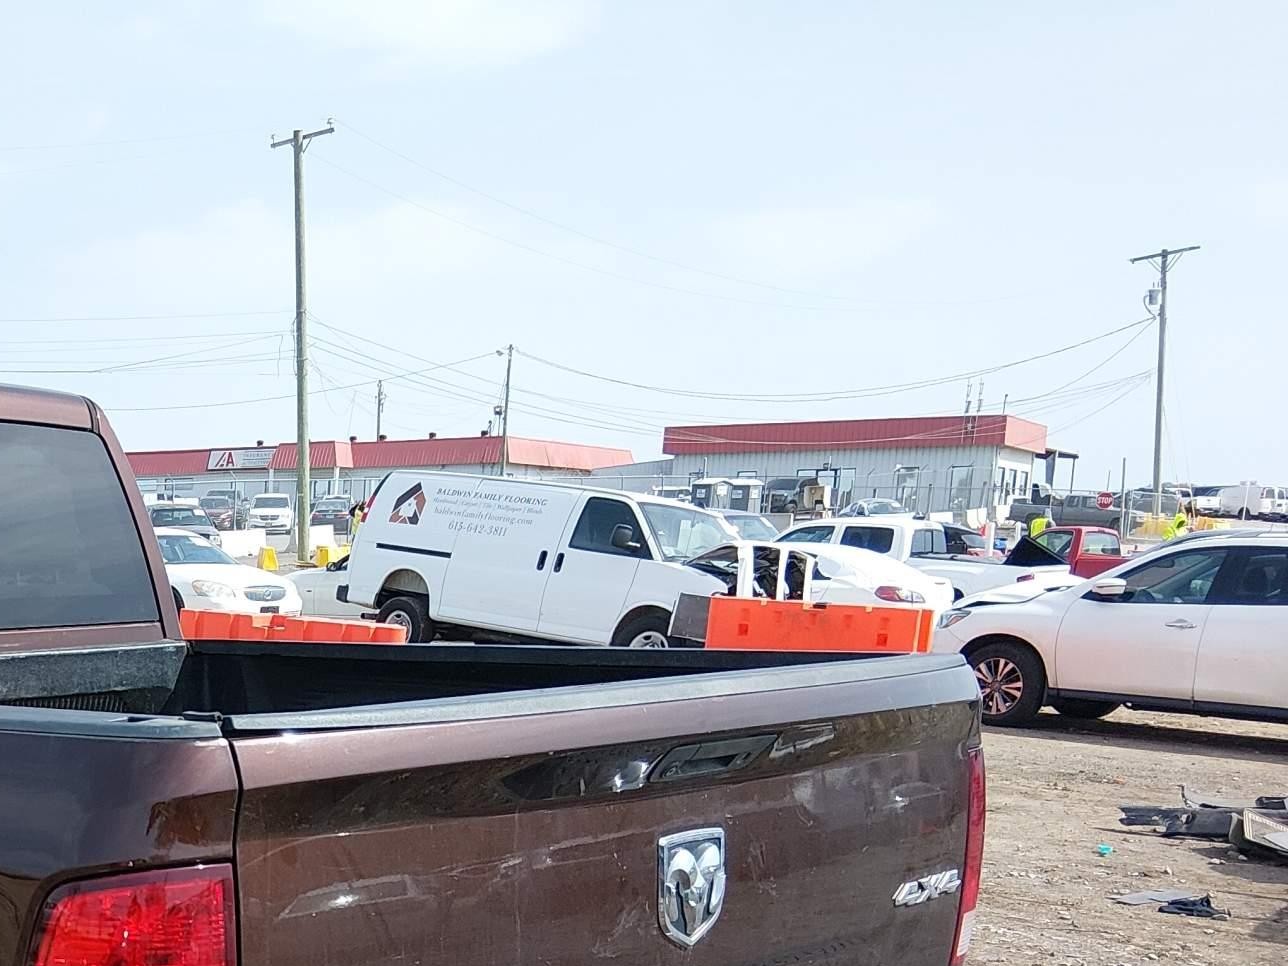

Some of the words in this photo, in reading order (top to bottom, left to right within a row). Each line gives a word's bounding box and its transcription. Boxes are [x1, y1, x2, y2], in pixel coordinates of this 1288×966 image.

[436, 488, 472, 499] BALDWIN
[473, 491, 502, 502] FAMILY
[503, 495, 549, 507] FLOORING
[1097, 496, 1112, 505] STOP
[433, 506, 534, 526] baldwinfamilyflooring.com
